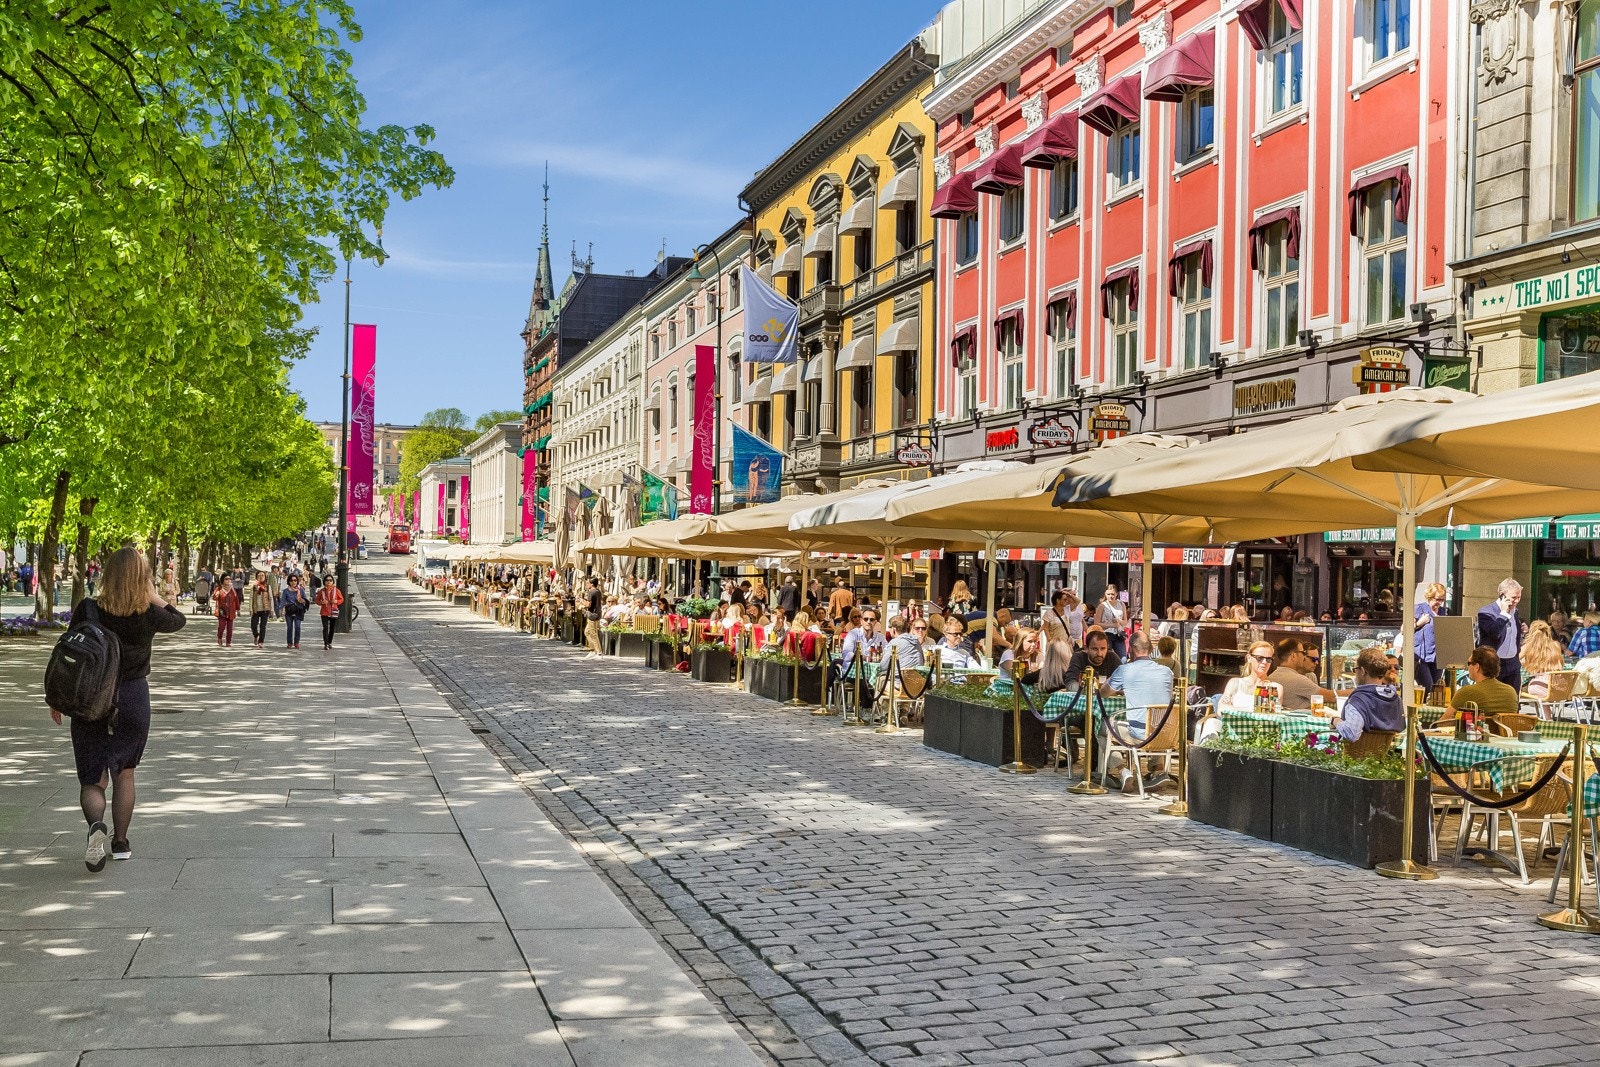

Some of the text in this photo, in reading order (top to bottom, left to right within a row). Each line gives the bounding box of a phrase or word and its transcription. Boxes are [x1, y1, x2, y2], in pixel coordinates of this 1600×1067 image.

[1515, 279, 1541, 308] THE
[1372, 349, 1400, 359] FRIDAY'S
[1364, 369, 1407, 382] AMERICAN BAR
[1235, 378, 1296, 408] AMERICAN BAR
[1037, 430, 1068, 438] FRIDAY'S
[1329, 528, 1397, 541] YOUR SECOND LIVING ROOM
[1480, 523, 1544, 539] BETTER THAN LIVE
[1563, 524, 1577, 538] THE
[1109, 548, 1139, 561] FRIDAYS
[1187, 549, 1224, 563] FRIDAYS
